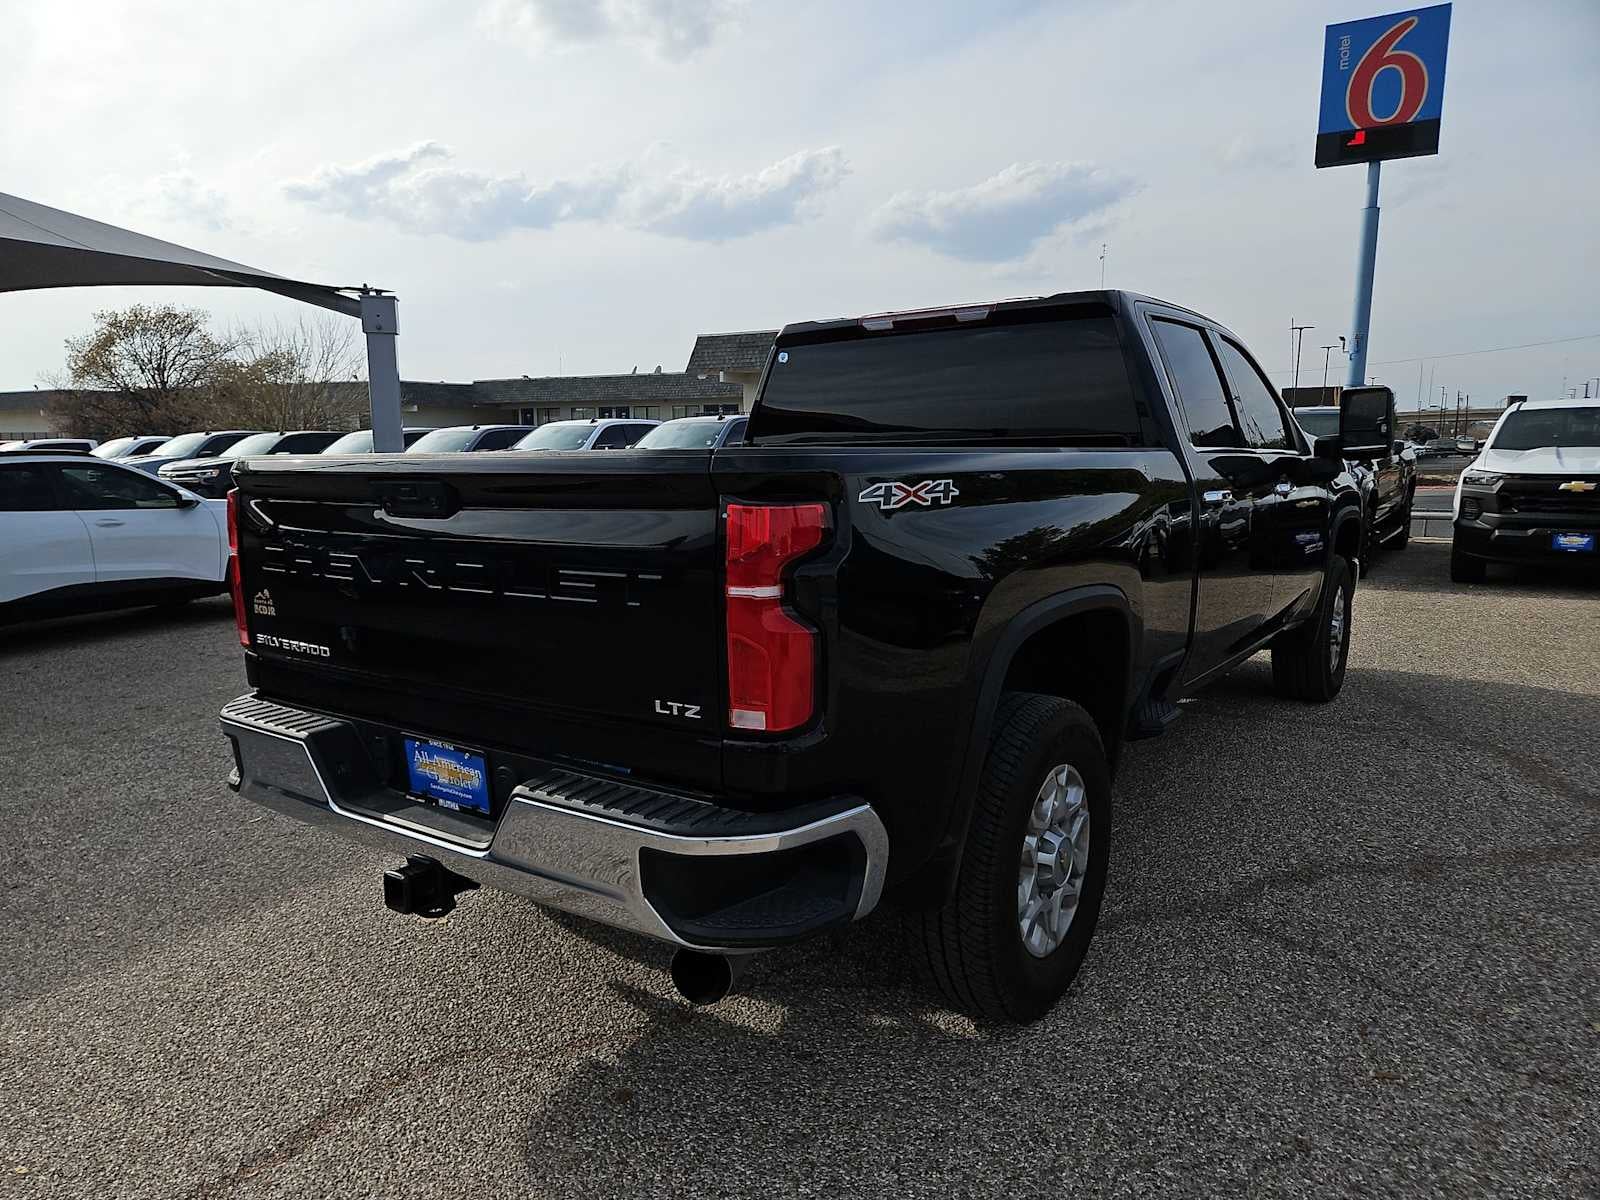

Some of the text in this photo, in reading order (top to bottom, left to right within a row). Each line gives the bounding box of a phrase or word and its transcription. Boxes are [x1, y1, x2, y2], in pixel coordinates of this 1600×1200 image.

[1339, 34, 1351, 70] motel
[1346, 16, 1428, 129] 6
[256, 633, 330, 657] SILVERADO
[655, 699, 701, 719] LTZ
